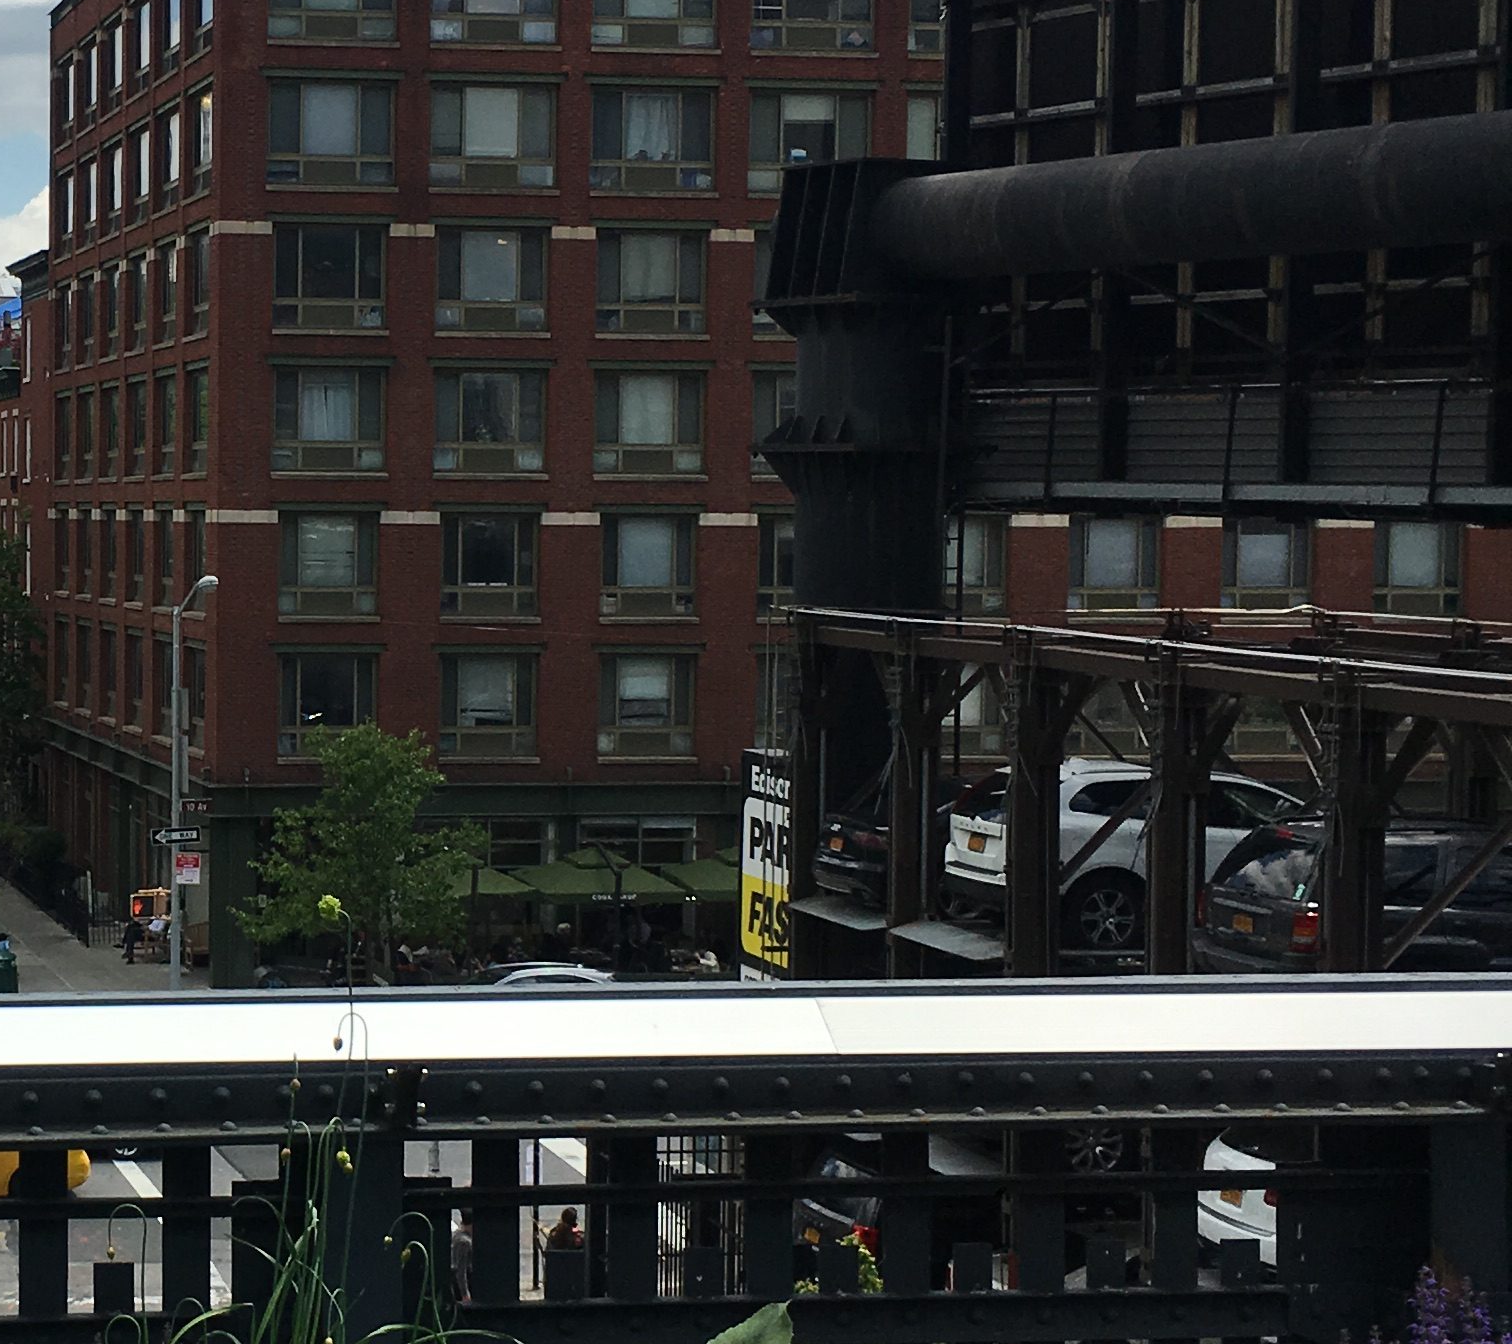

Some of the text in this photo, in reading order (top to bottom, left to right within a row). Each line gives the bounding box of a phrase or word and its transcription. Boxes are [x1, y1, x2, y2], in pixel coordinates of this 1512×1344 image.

[186, 802, 207, 811] 10 Av
[749, 816, 790, 870] PAR
[748, 890, 790, 946] FAS
